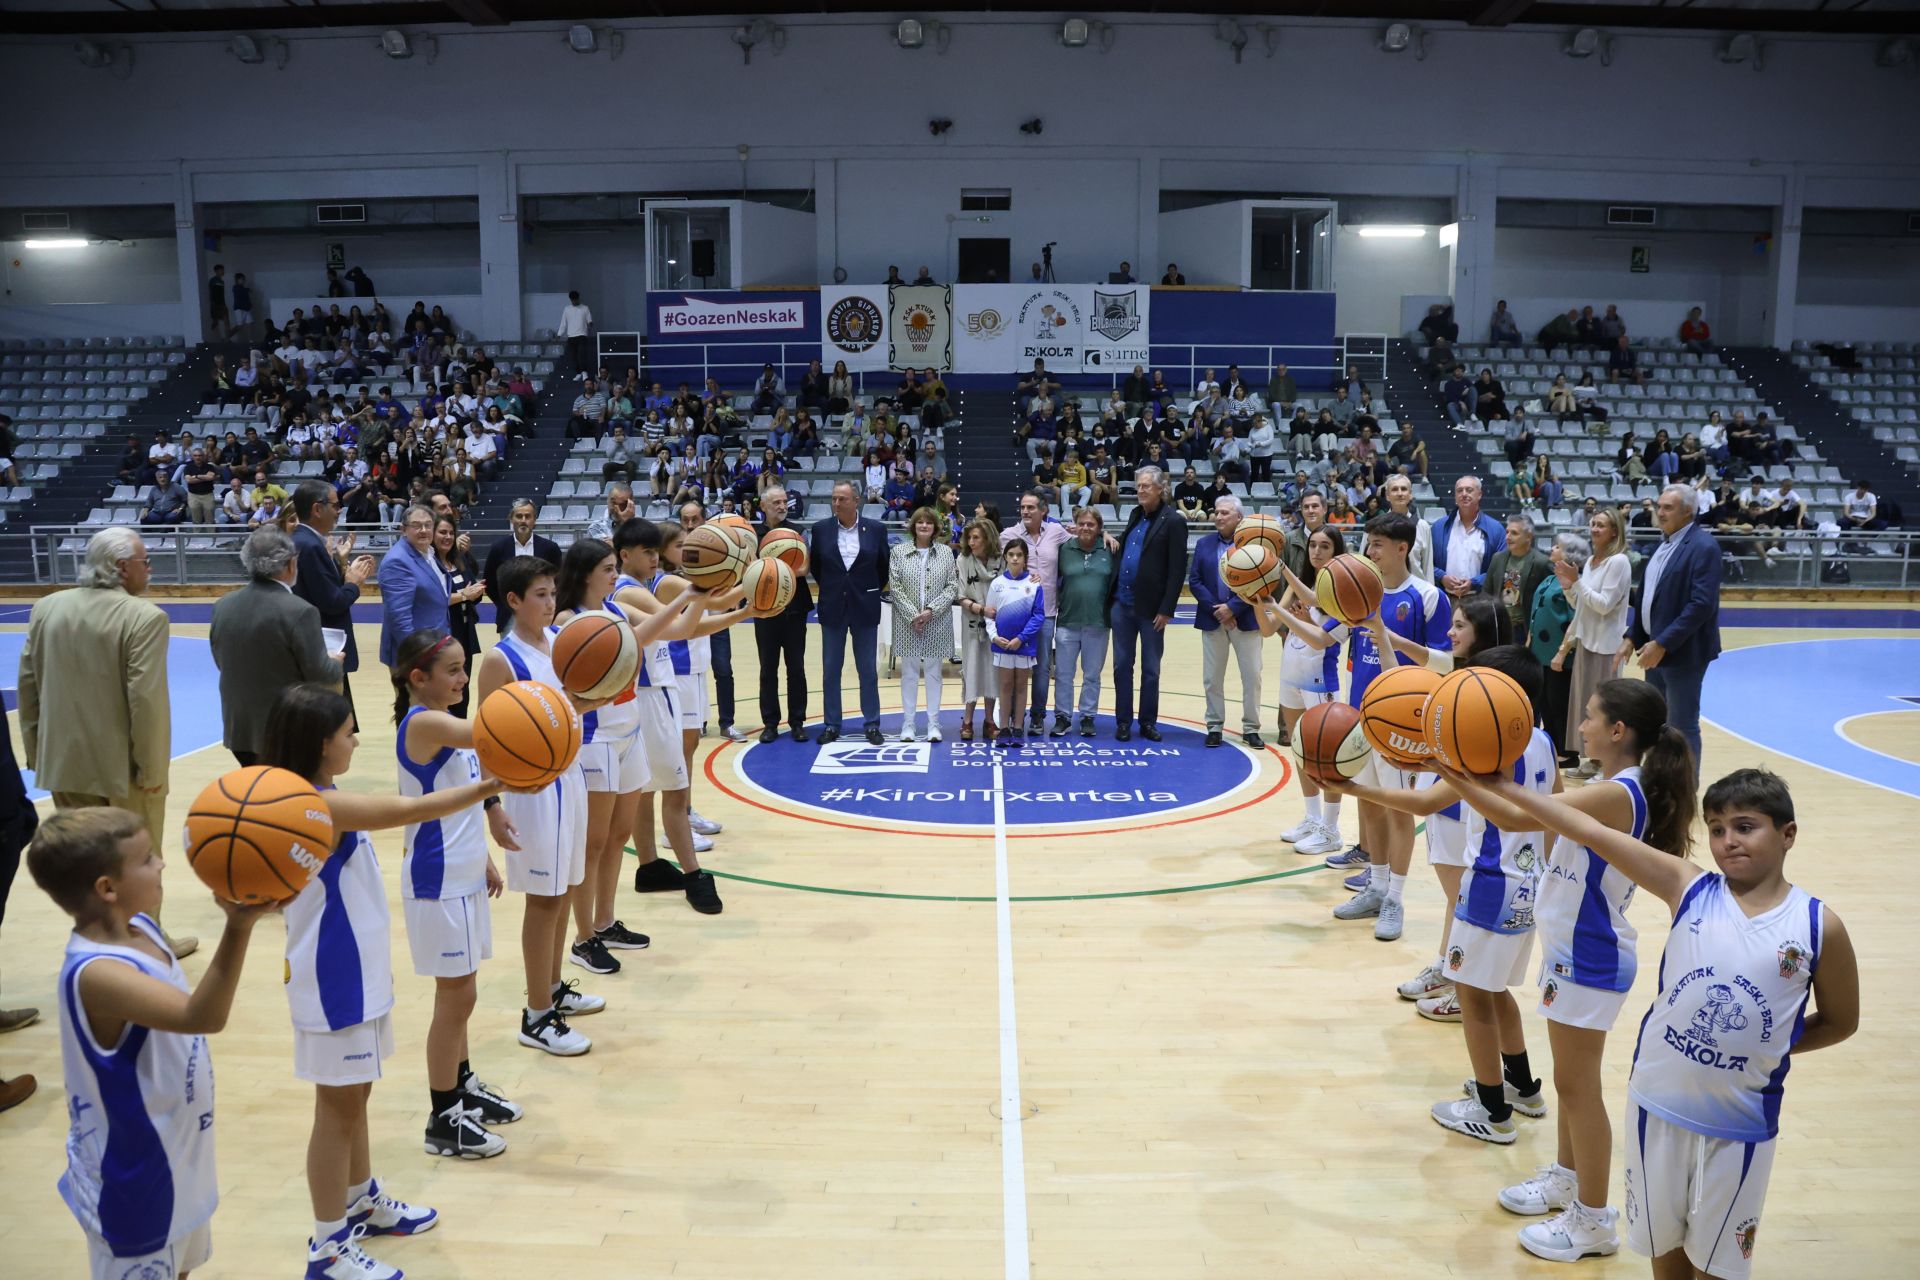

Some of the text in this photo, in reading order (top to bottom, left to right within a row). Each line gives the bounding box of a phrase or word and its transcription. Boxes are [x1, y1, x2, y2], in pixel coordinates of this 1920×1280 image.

[664, 308, 797, 327] #GoazenNeskak
[1024, 347, 1074, 357] ESKOLA
[1020, 748, 1181, 756] SEBASTIÁN
[1387, 731, 1433, 755] Wils
[820, 789, 1179, 802] #KirolTxartela
[1667, 966, 1715, 1006] ASKATUAK
[1663, 1024, 1749, 1072] ESKOLA
